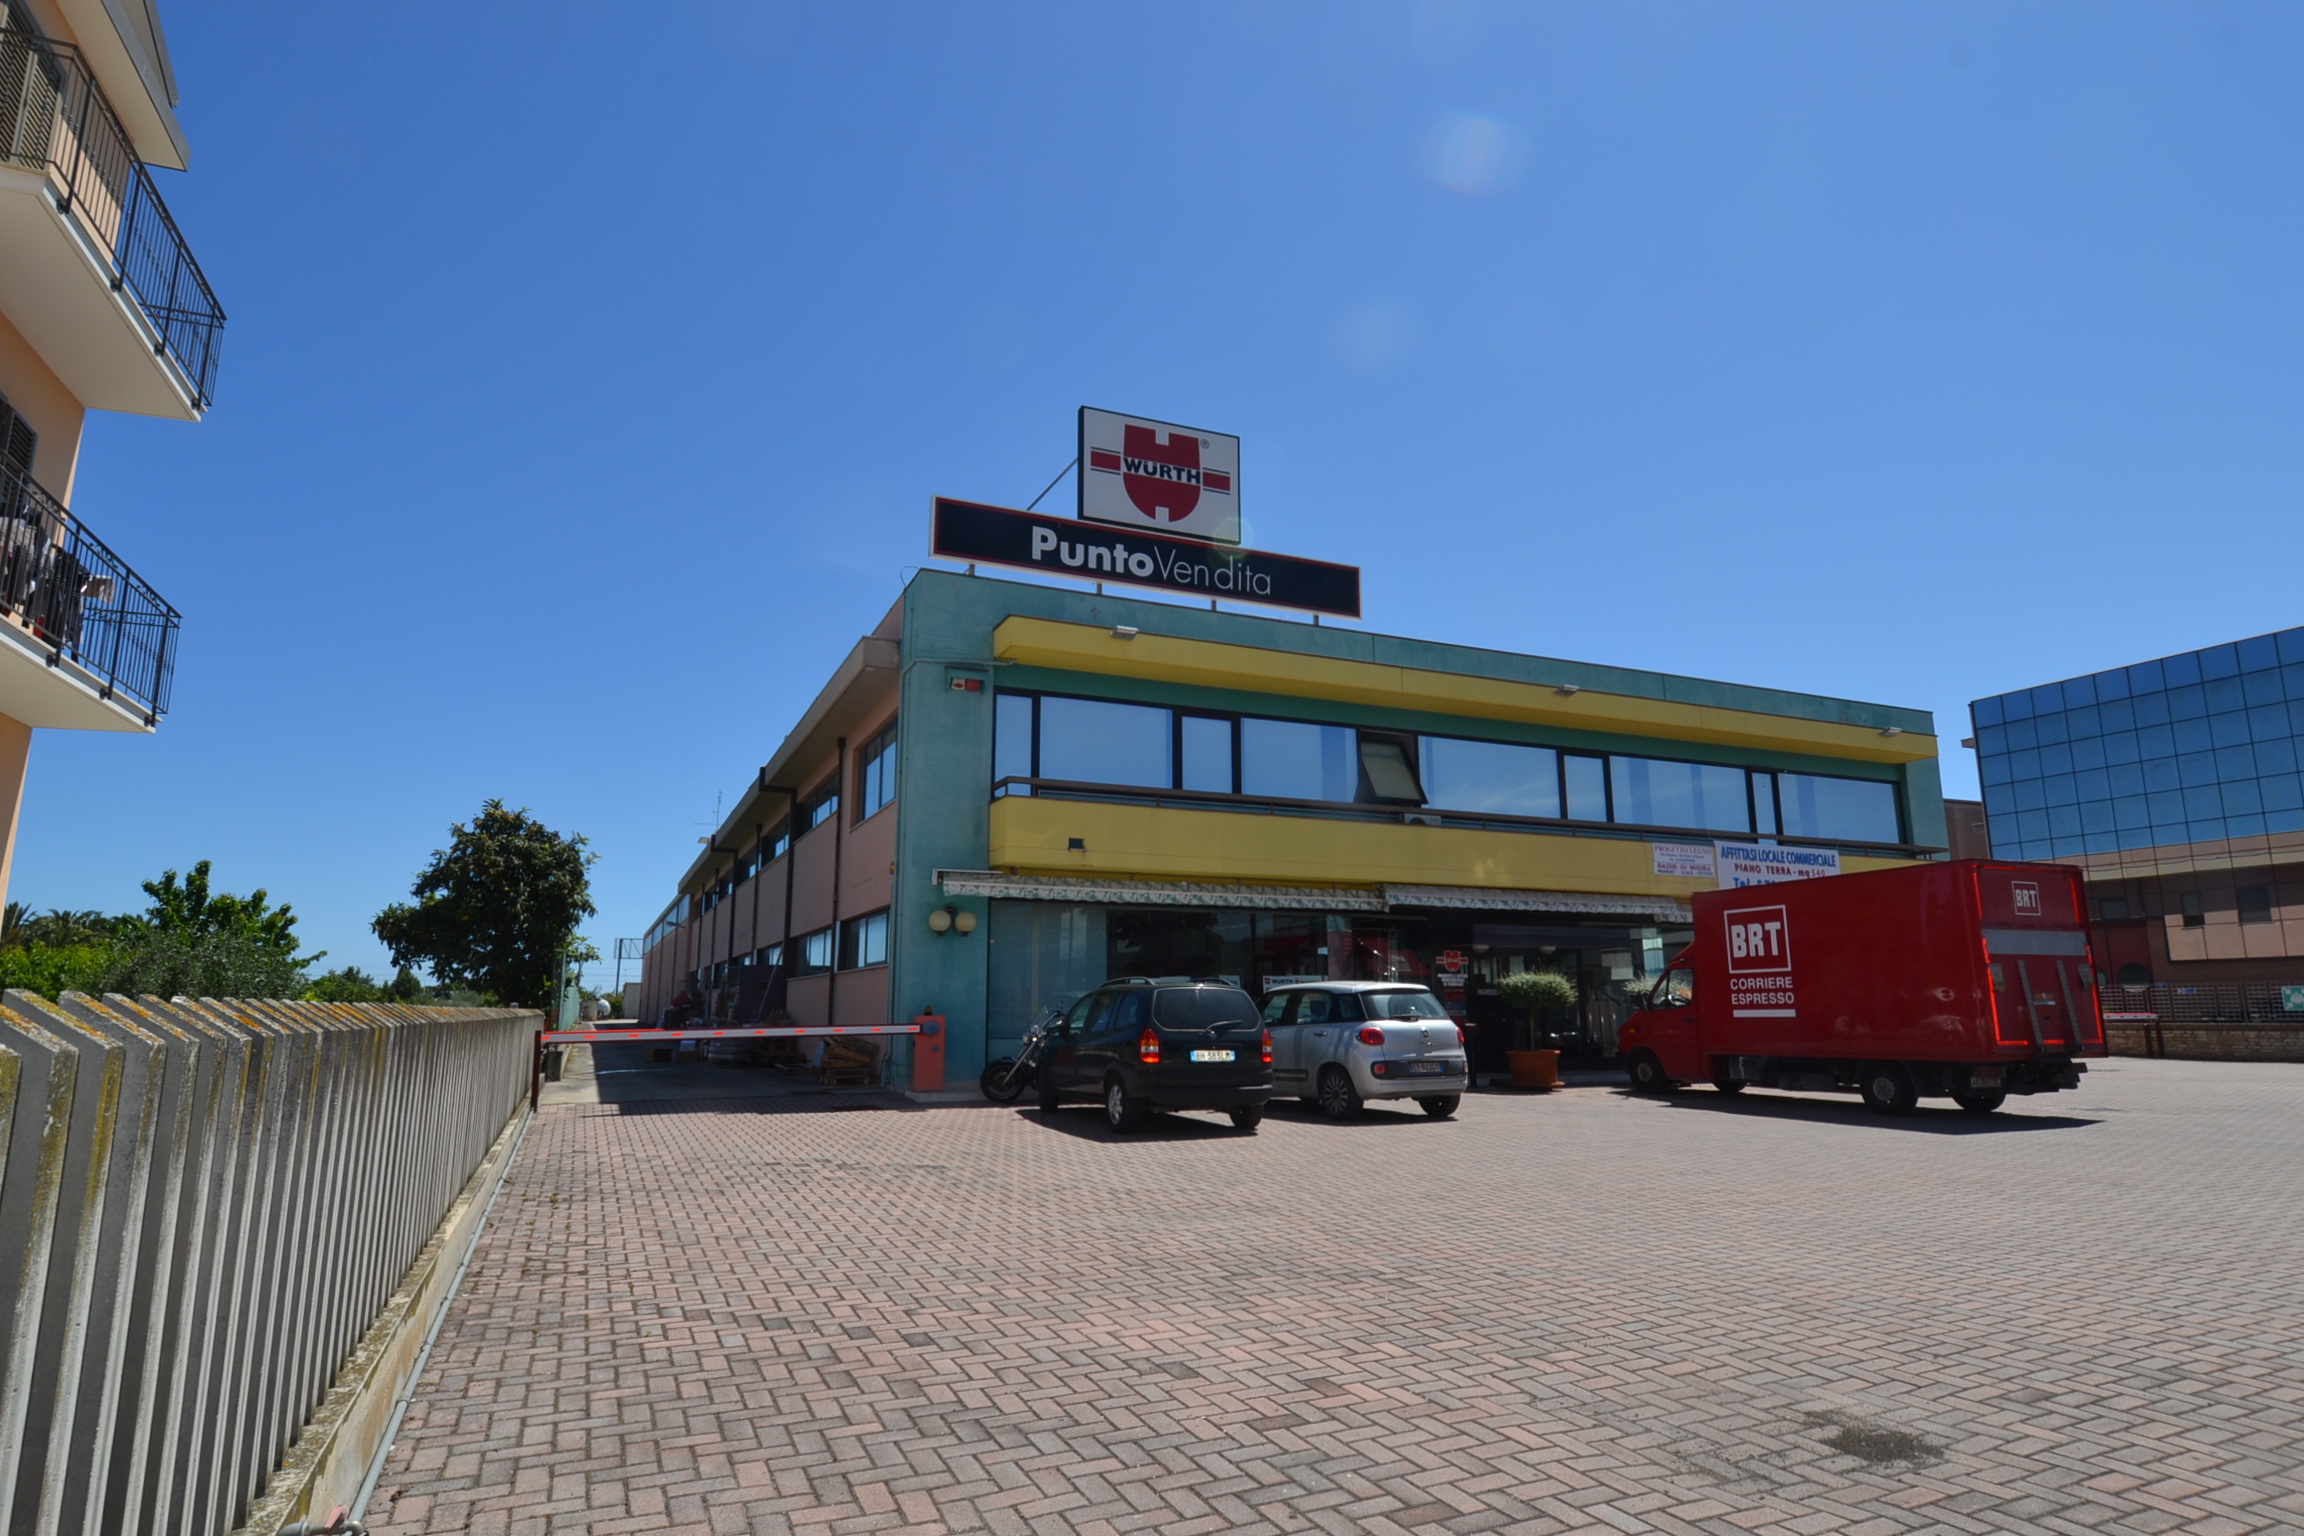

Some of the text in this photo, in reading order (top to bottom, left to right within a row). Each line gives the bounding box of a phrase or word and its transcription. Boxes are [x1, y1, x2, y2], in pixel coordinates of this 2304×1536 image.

[1123, 457, 1200, 485] WÜRTH
[1721, 846, 1836, 868] AFFITTASI LOCALE COMMERCIALE
[1734, 863, 1761, 874] PIANO
[1765, 865, 1792, 876] TERRA
[1811, 868, 1826, 877] 540
[2015, 889, 2036, 908] BRT
[1731, 921, 1781, 958] BRT
[1730, 977, 1793, 990] CORRIERE
[1477, 988, 1500, 996] INGRESS
[1731, 992, 1794, 1005] ESPRESSO
